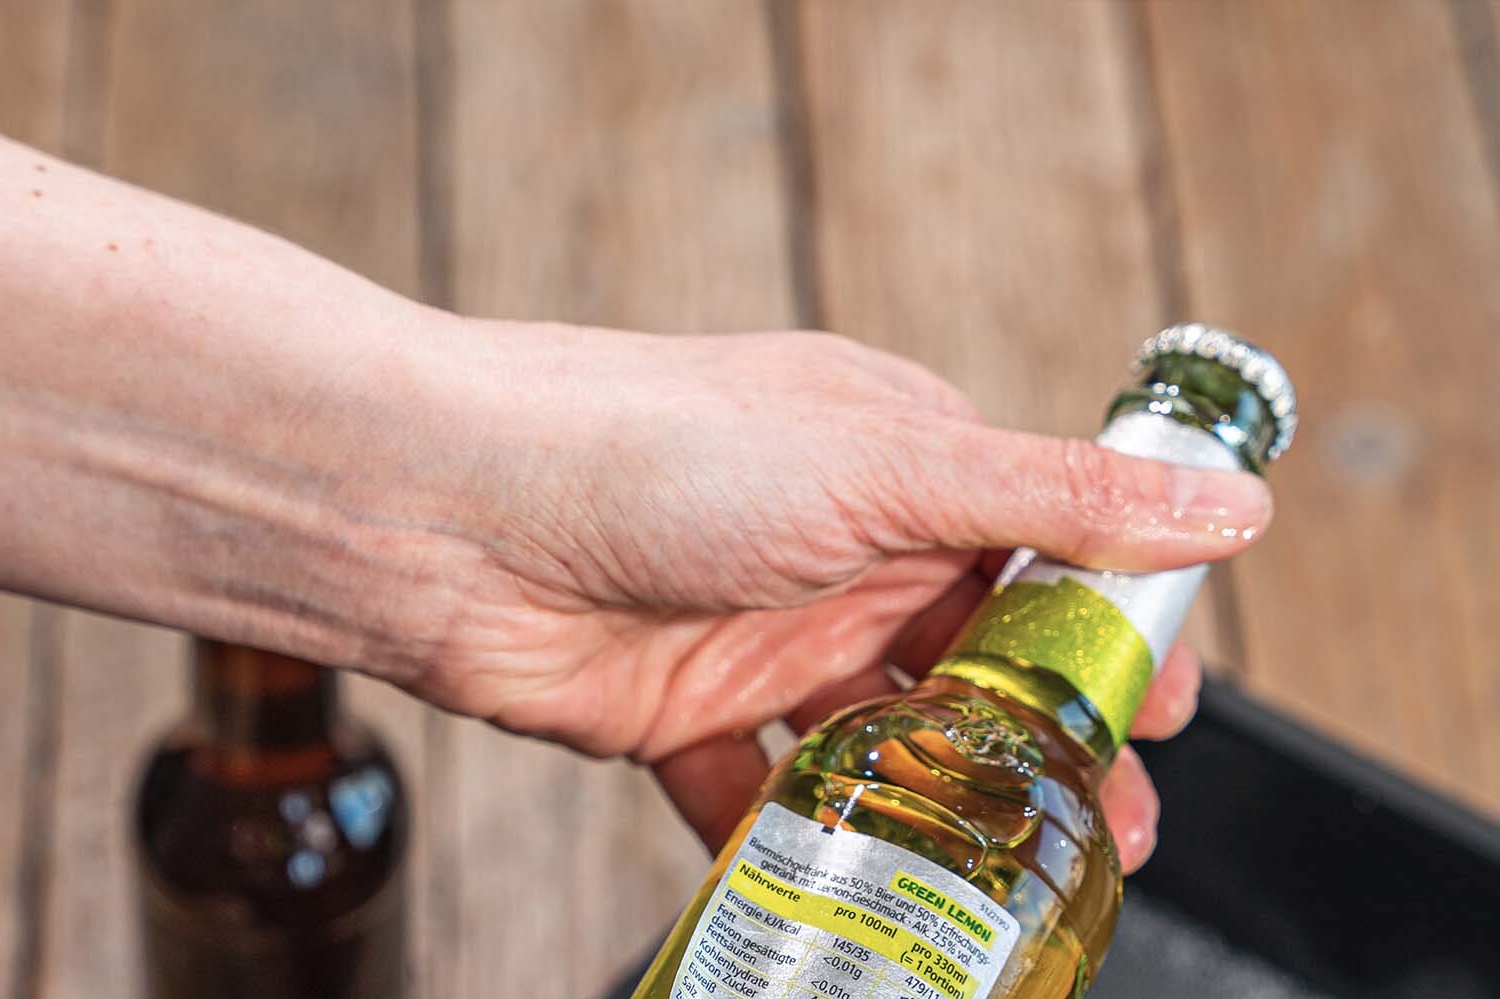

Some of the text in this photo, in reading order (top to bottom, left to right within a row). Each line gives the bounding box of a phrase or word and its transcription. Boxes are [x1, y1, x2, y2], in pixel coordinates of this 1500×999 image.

[724, 889, 762, 920] Energie
[763, 913, 801, 935] kJ/kcal
[832, 938, 871, 962] 145/35
[739, 864, 968, 985] Nährwerte pro 100ml pro 330ml
[749, 837, 991, 965] Biermischgetränk aus 50% Bier und 50% Erfrischungs-
[761, 860, 797, 882] getränk
[912, 921, 930, 938] Alk.
[931, 932, 956, 955] 2,5%
[957, 949, 971, 968] vol.
[898, 877, 946, 909] GREEN
[947, 904, 992, 942] LEMON
[699, 938, 769, 989] Kohlenhydrate
[706, 925, 757, 966] Fettsäuren
[712, 916, 796, 965] davon gesättigte
[717, 903, 736, 923] Fett
[823, 956, 863, 981] <0,01g
[916, 960, 923, 971] 1
[681, 975, 698, 998] Salz
[688, 962, 717, 993] Eiweiß
[694, 949, 721, 977] davon
[721, 973, 758, 998] Zucker
